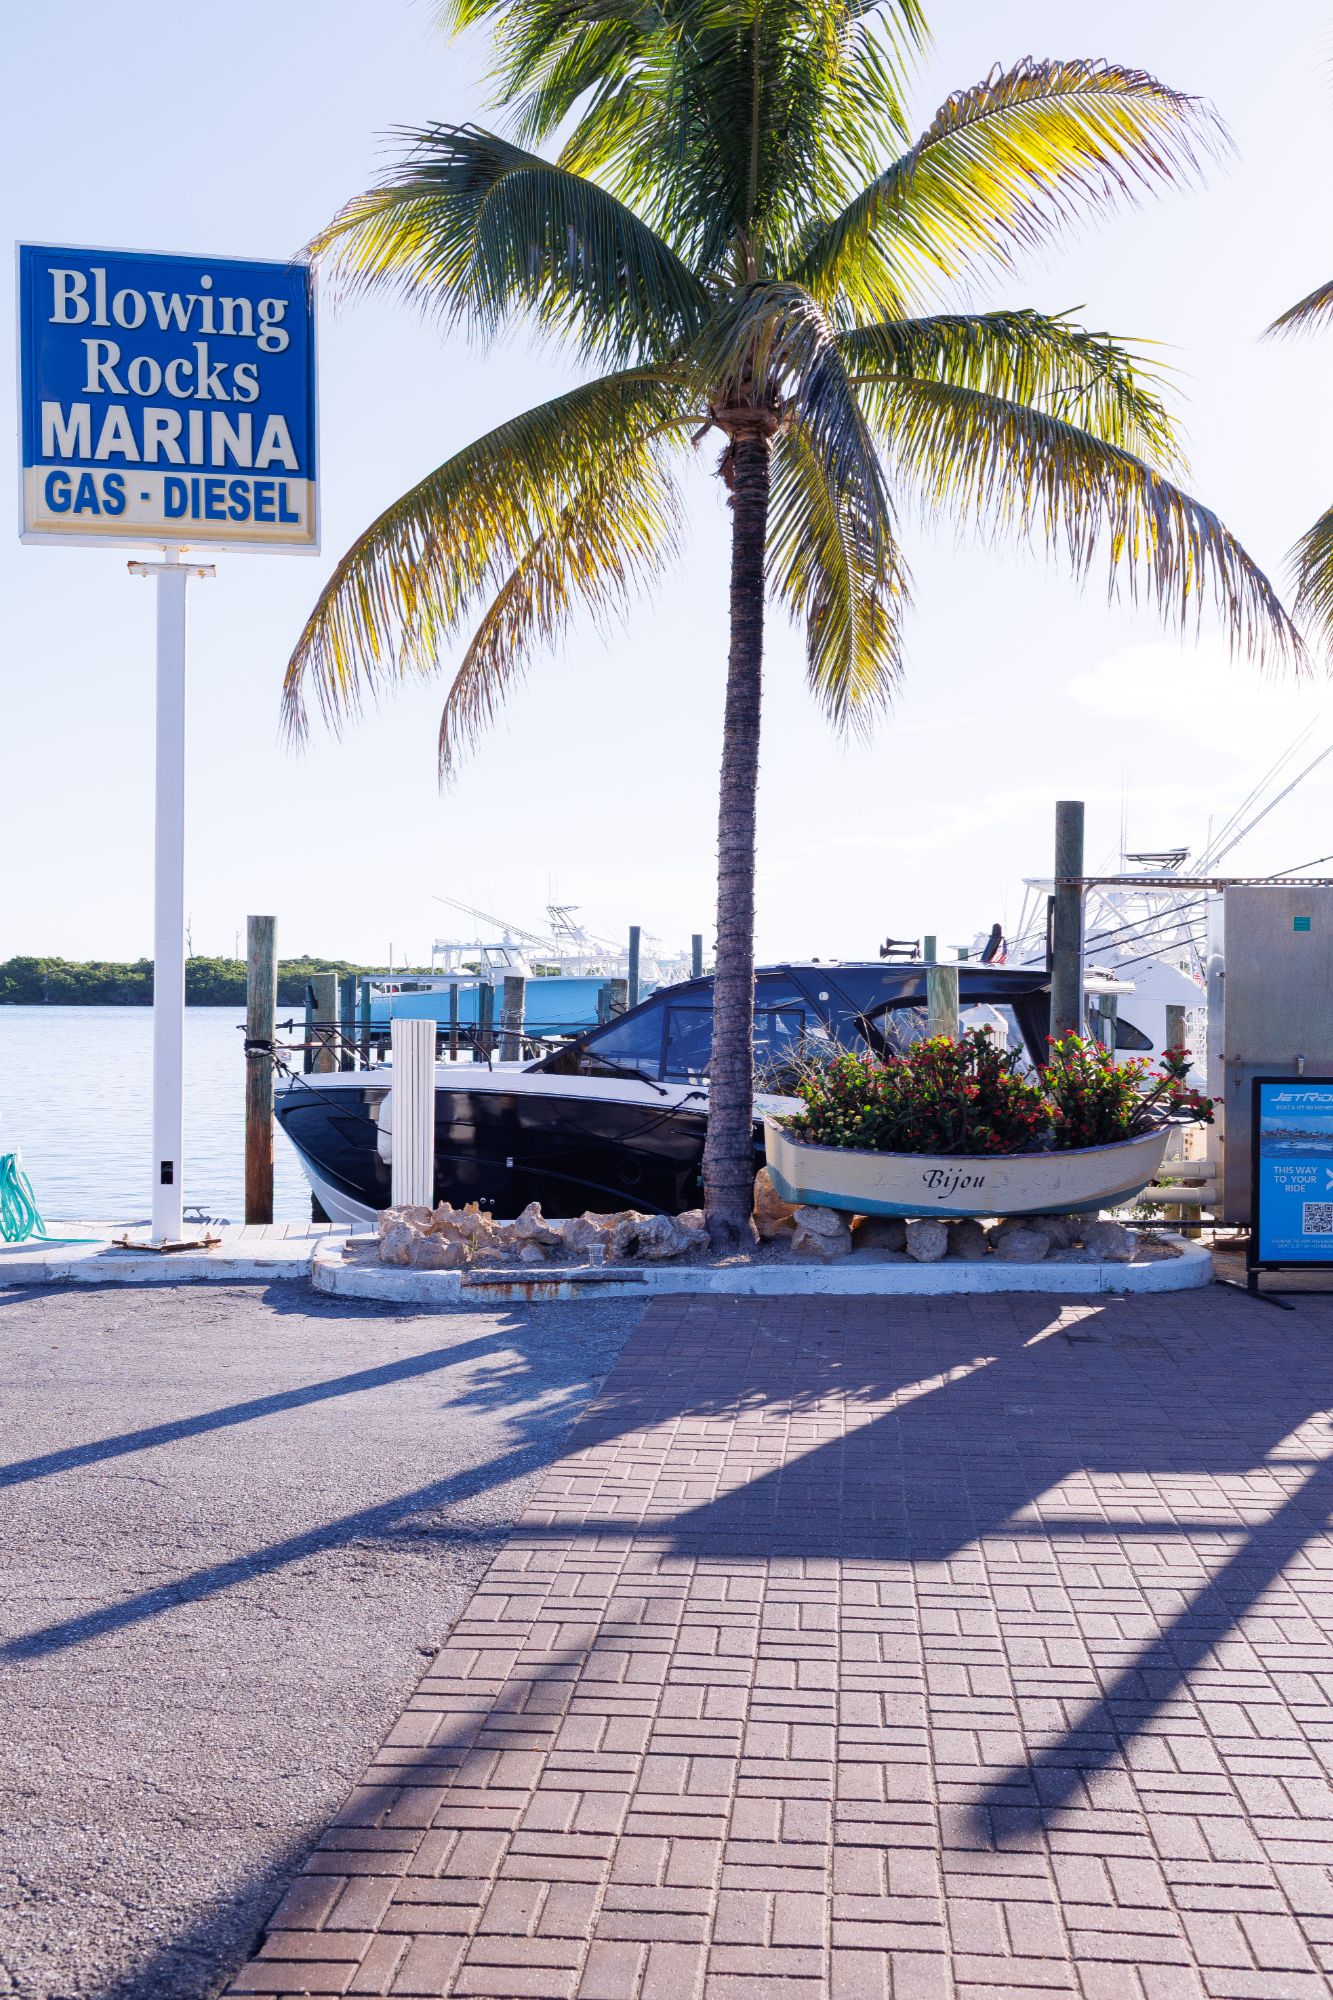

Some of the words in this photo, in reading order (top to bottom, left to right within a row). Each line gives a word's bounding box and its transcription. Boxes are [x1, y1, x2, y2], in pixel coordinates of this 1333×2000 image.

[47, 267, 290, 353] Blowing
[80, 338, 260, 403] Rocks
[41, 401, 299, 470] MARINA
[44, 470, 126, 516] GAS
[163, 476, 299, 524] DIESEL
[922, 1168, 986, 1199] Bijou
[1273, 1166, 1294, 1174] THIS
[1295, 1166, 1318, 1174] WAY
[1273, 1175, 1287, 1183] TO
[1291, 1175, 1317, 1183] YOUR
[1285, 1184, 1306, 1192] RIDE
